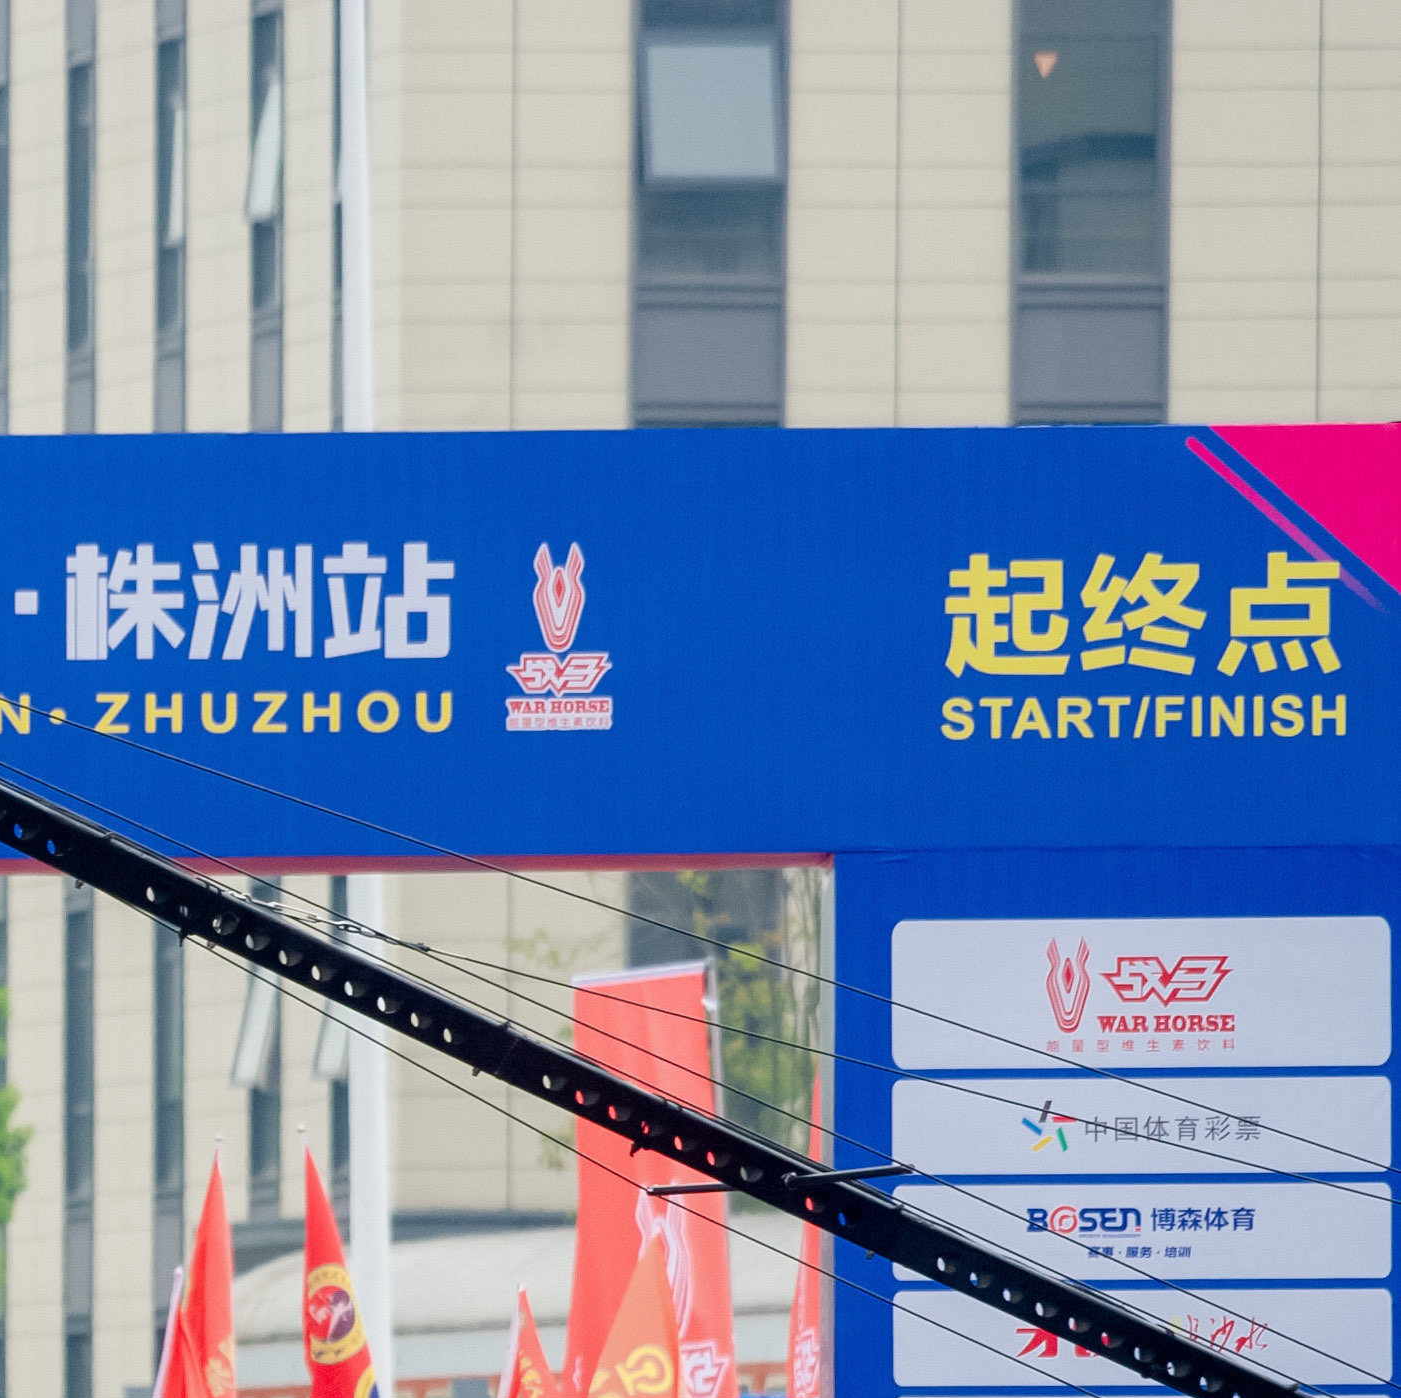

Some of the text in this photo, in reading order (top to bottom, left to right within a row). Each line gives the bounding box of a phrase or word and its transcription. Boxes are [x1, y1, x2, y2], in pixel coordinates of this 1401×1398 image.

[945, 552, 1341, 677] 起终点
[96, 692, 454, 734] ZHUZHOU
[509, 700, 610, 714] WAR HORSE
[940, 695, 1347, 740] START/FINISH
[1097, 1013, 1236, 1034] WAR HORSE
[1083, 1114, 1262, 1144] 中国体育彩票
[1150, 1206, 1256, 1232] 博森体育
